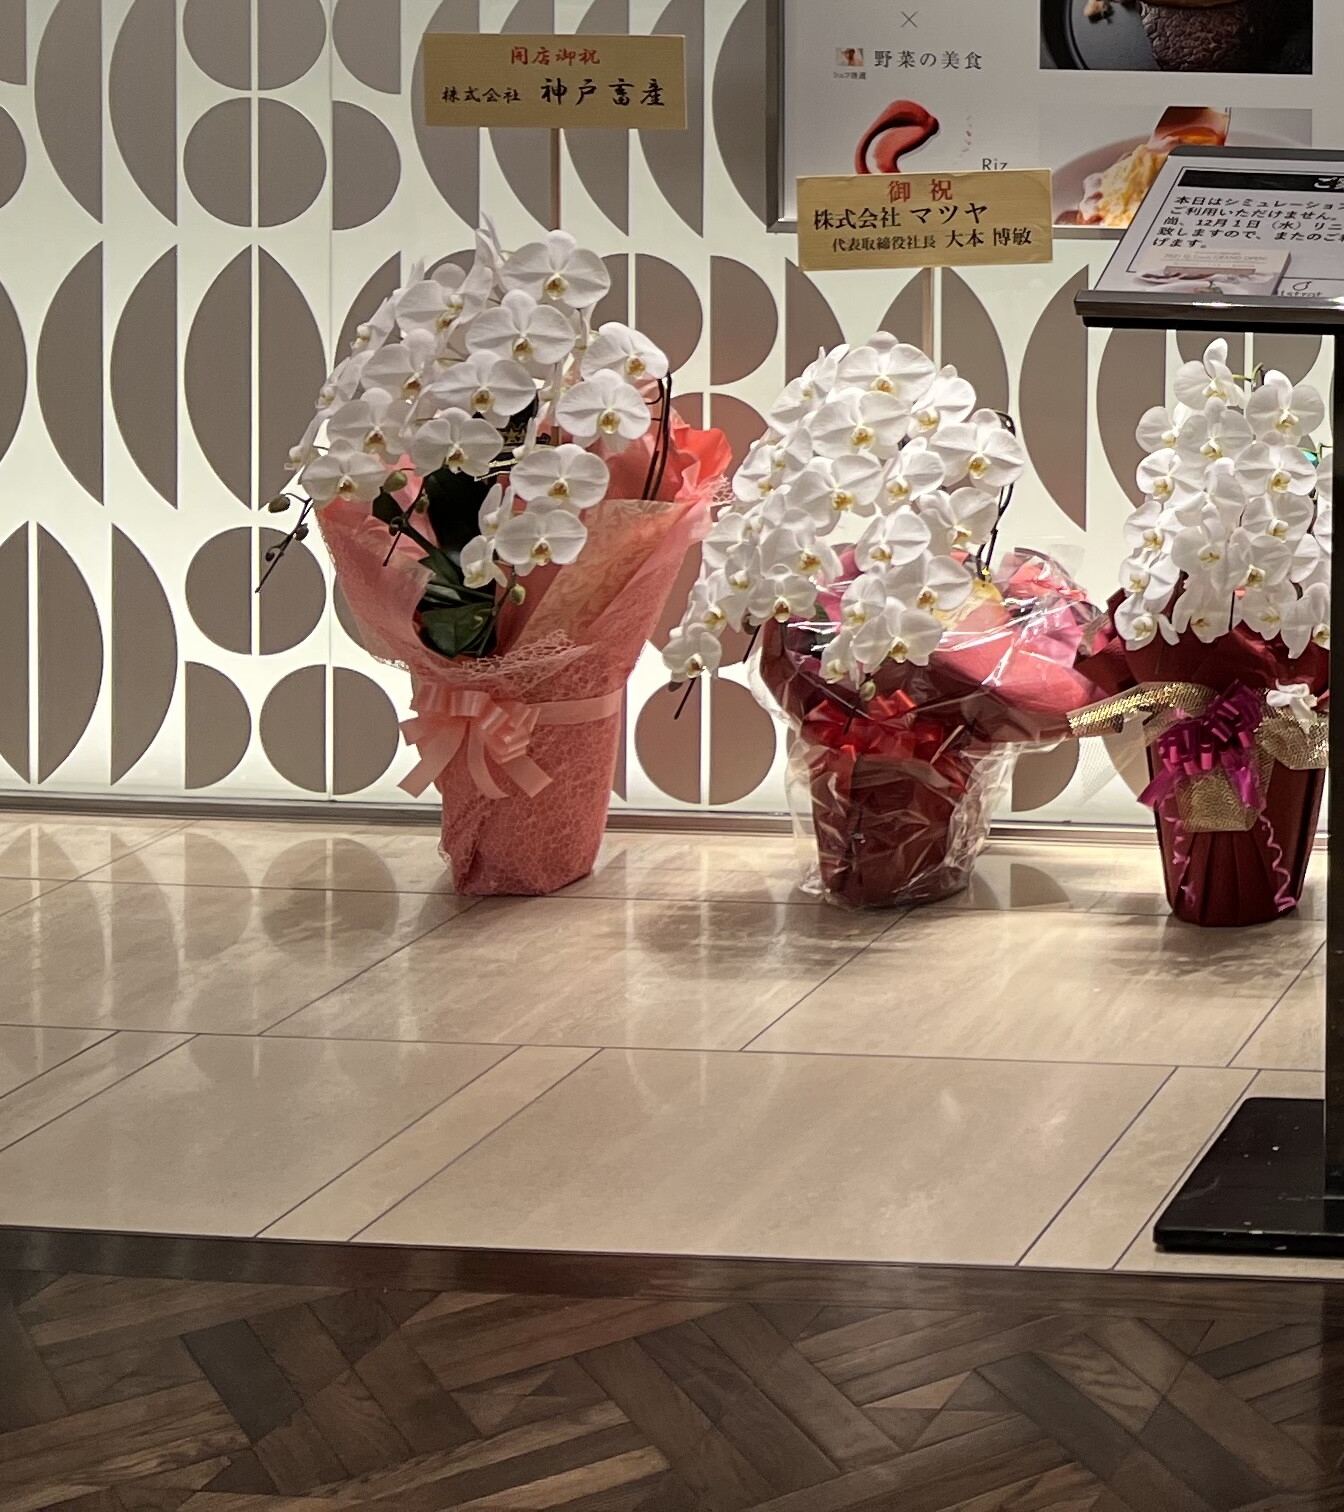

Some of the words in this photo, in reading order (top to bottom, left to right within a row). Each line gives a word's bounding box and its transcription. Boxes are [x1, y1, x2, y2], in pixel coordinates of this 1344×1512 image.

[510, 46, 601, 67] 開店御祝
[873, 49, 983, 70] 野菜の美食
[441, 86, 522, 104] 株式会社
[539, 77, 666, 107] 神戸畜産
[981, 157, 1009, 171] Riz
[813, 206, 902, 231] 株式会社
[908, 202, 989, 225] マツヤ
[1169, 206, 1337, 221] ご利用いただけません。
[832, 234, 936, 253] 代表取締役社長
[1152, 237, 1207, 249] げます。
